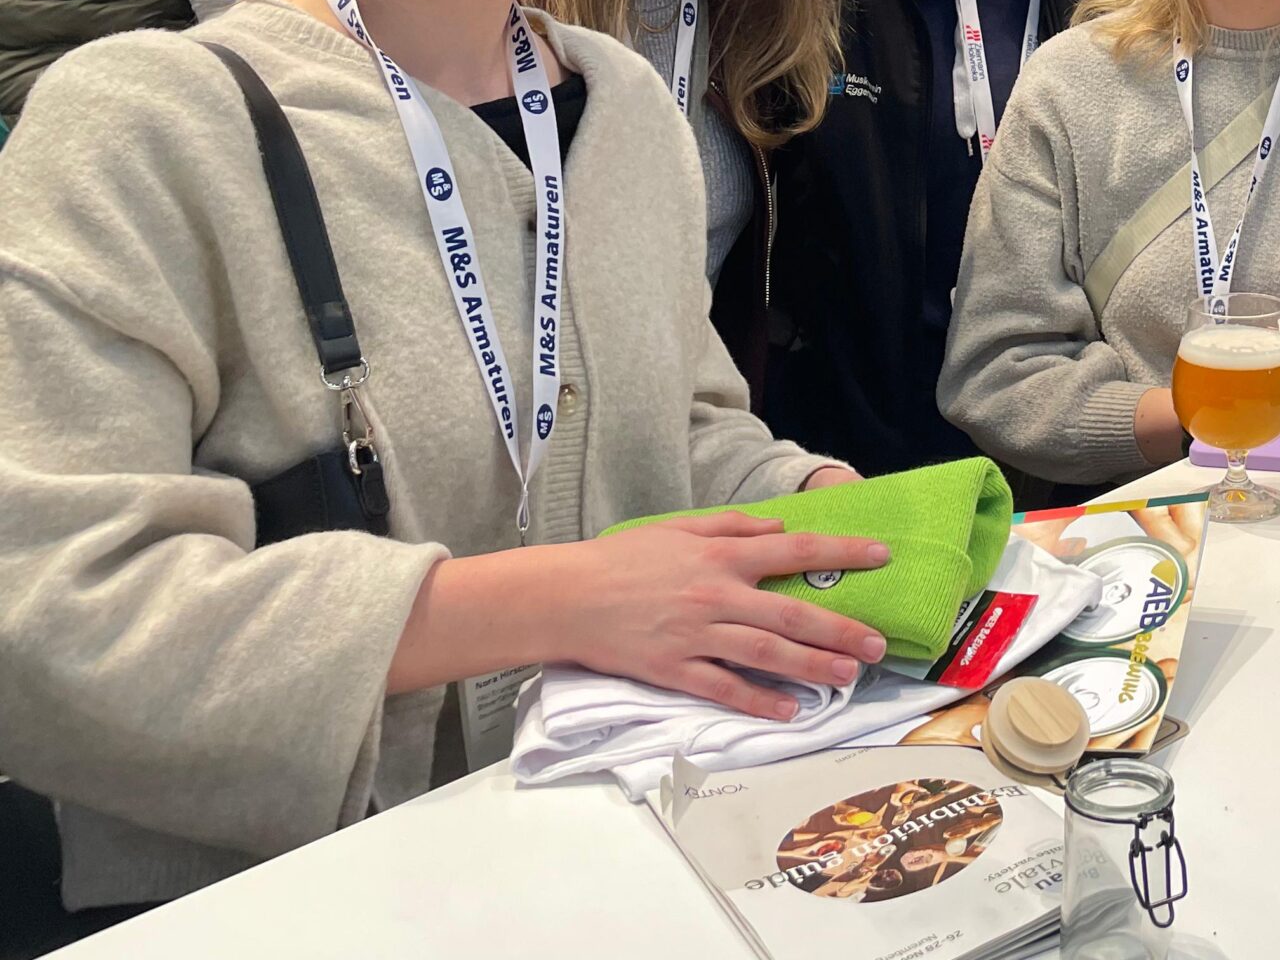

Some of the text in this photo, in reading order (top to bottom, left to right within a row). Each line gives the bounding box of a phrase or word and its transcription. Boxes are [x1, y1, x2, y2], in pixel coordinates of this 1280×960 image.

[512, 26, 537, 73] M&S
[1193, 170, 1206, 213] M&S
[539, 175, 558, 377] M&S Armaturen
[442, 226, 515, 440] M&S Armaturen
[1139, 577, 1173, 629] AEB
[1118, 632, 1152, 704] BREWING
[684, 783, 750, 800] YONTEX
[744, 785, 1027, 891] Exhibition guide
[994, 858, 1064, 893] viale
